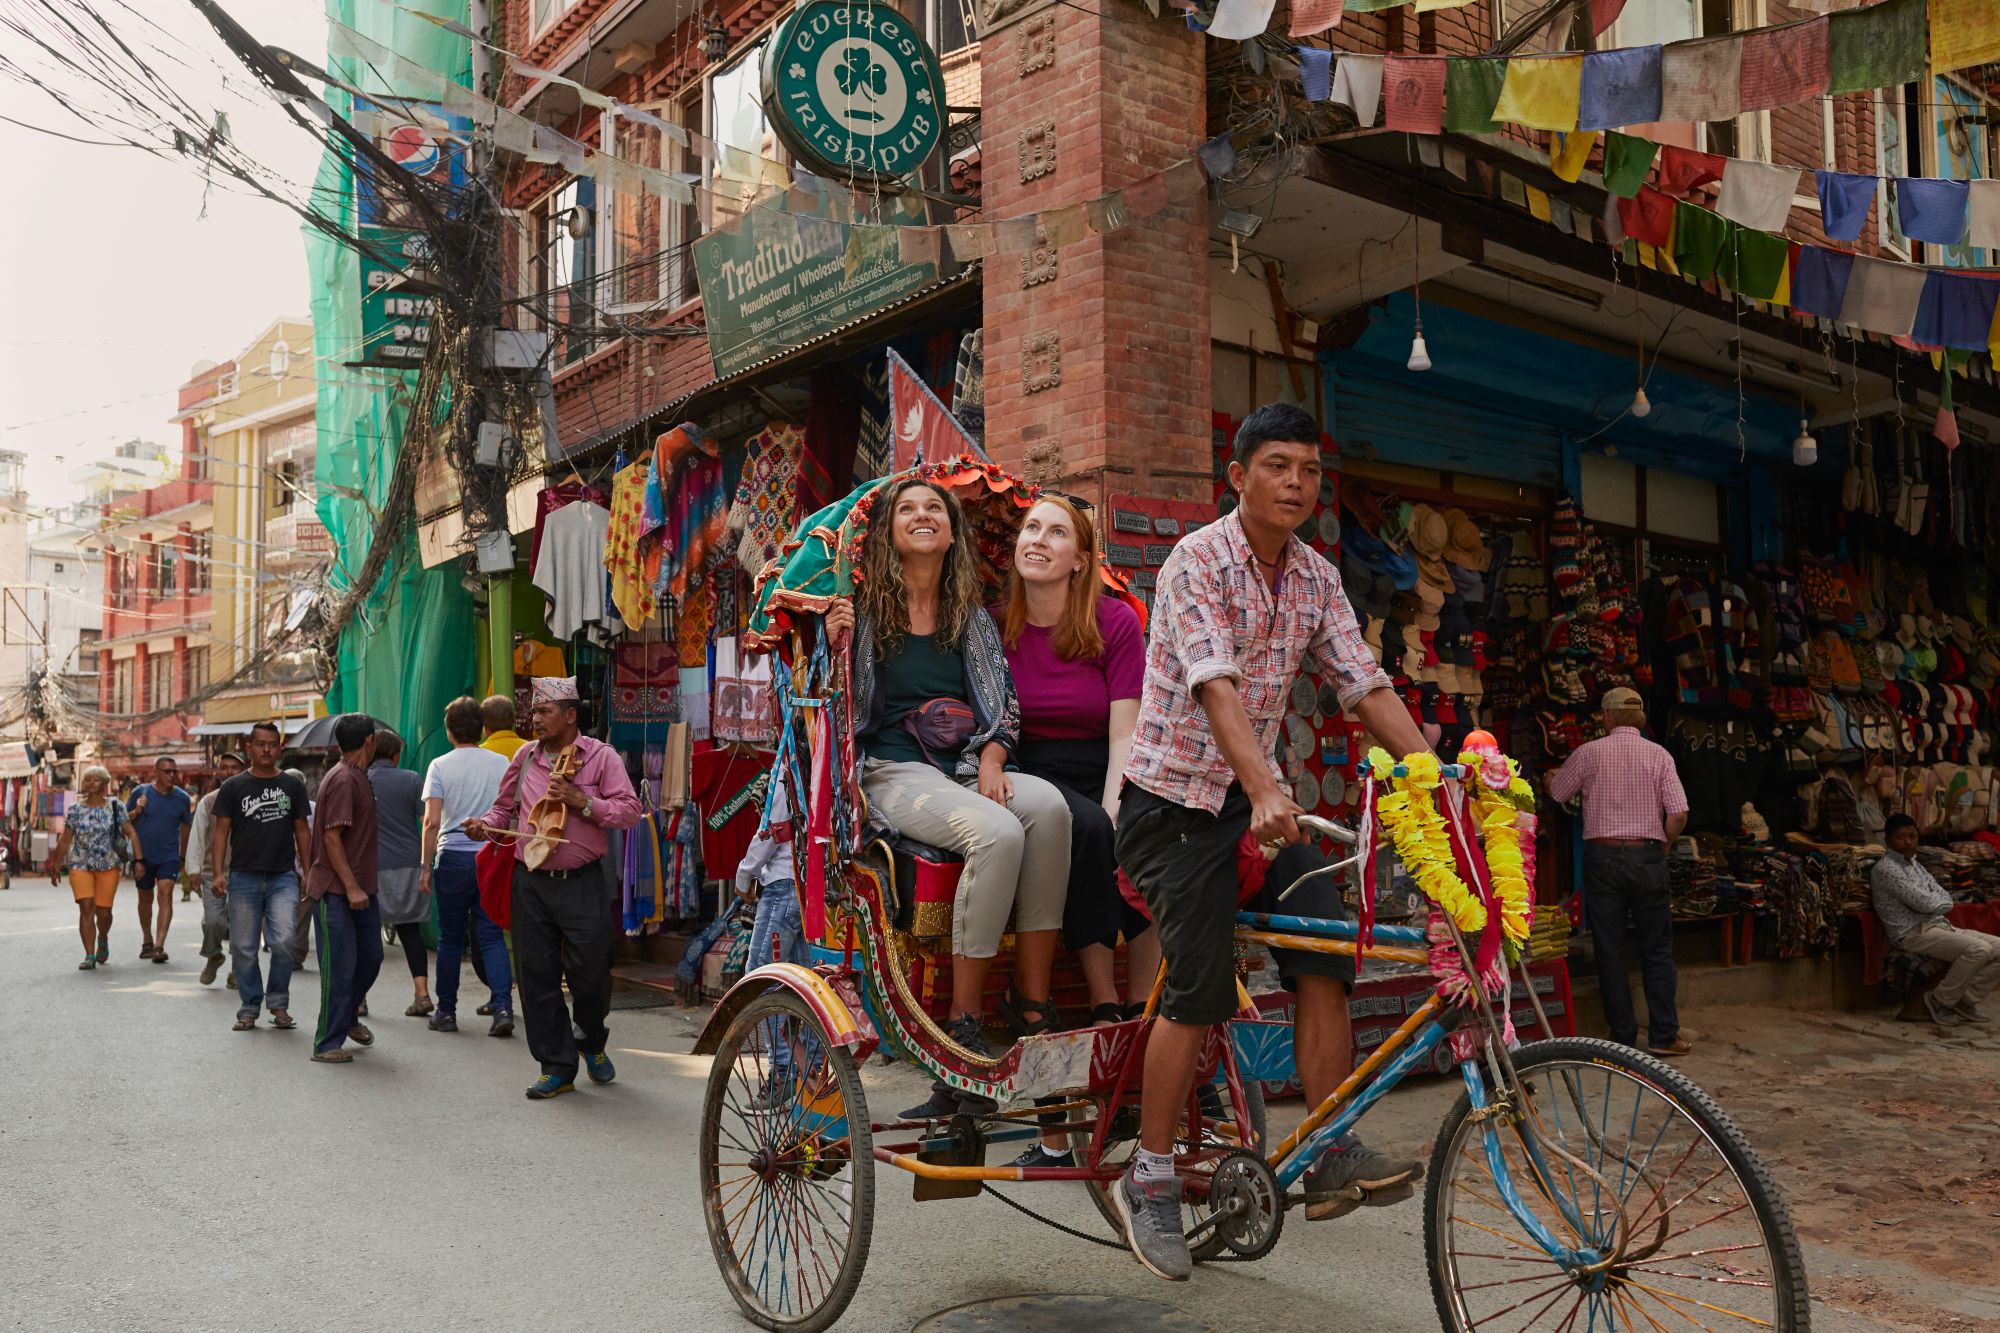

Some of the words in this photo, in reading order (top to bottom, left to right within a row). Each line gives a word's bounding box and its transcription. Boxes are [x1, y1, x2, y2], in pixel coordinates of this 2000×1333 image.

[740, 283, 790, 318] Manufacturer
[750, 315, 775, 334] Woollen
[777, 301, 806, 322] Sweaters
[810, 285, 836, 307] Jackets
[394, 324, 430, 342] PU
[709, 809, 729, 829] 100%
[724, 788, 752, 816] Cashmere
